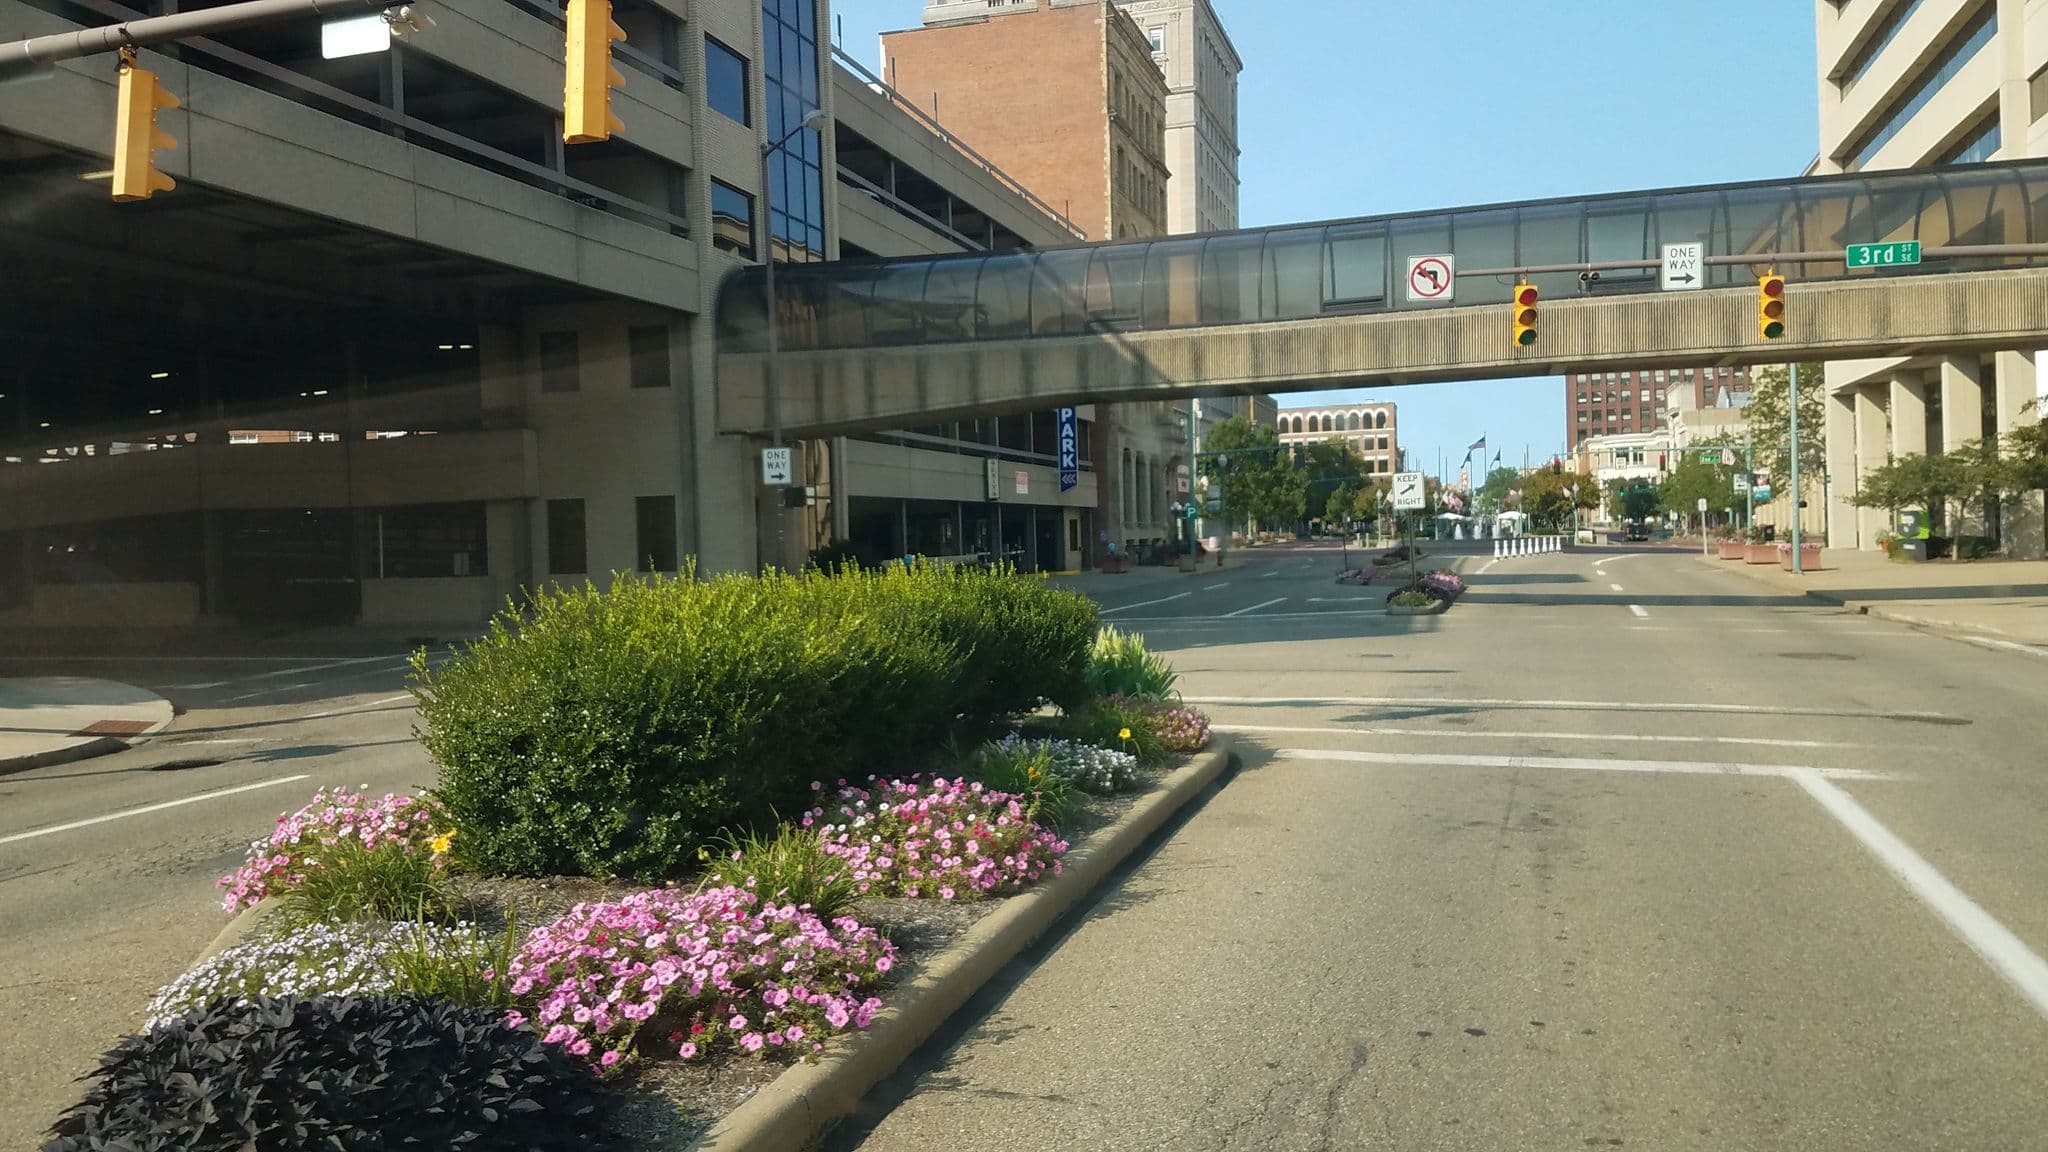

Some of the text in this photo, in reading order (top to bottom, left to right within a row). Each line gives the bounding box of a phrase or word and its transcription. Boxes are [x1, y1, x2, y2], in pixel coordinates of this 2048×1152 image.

[1670, 247, 1695, 258] ONE
[1859, 243, 1912, 264] 3rd ST
[1901, 253, 1912, 262] SE
[1670, 259, 1696, 270] WAY
[1061, 407, 1075, 468] PARK
[767, 450, 786, 460] ONE
[767, 461, 786, 470] WAY
[1397, 474, 1418, 482] KEEP
[1397, 497, 1421, 505] RIGHT
[1187, 507, 1196, 518] P
